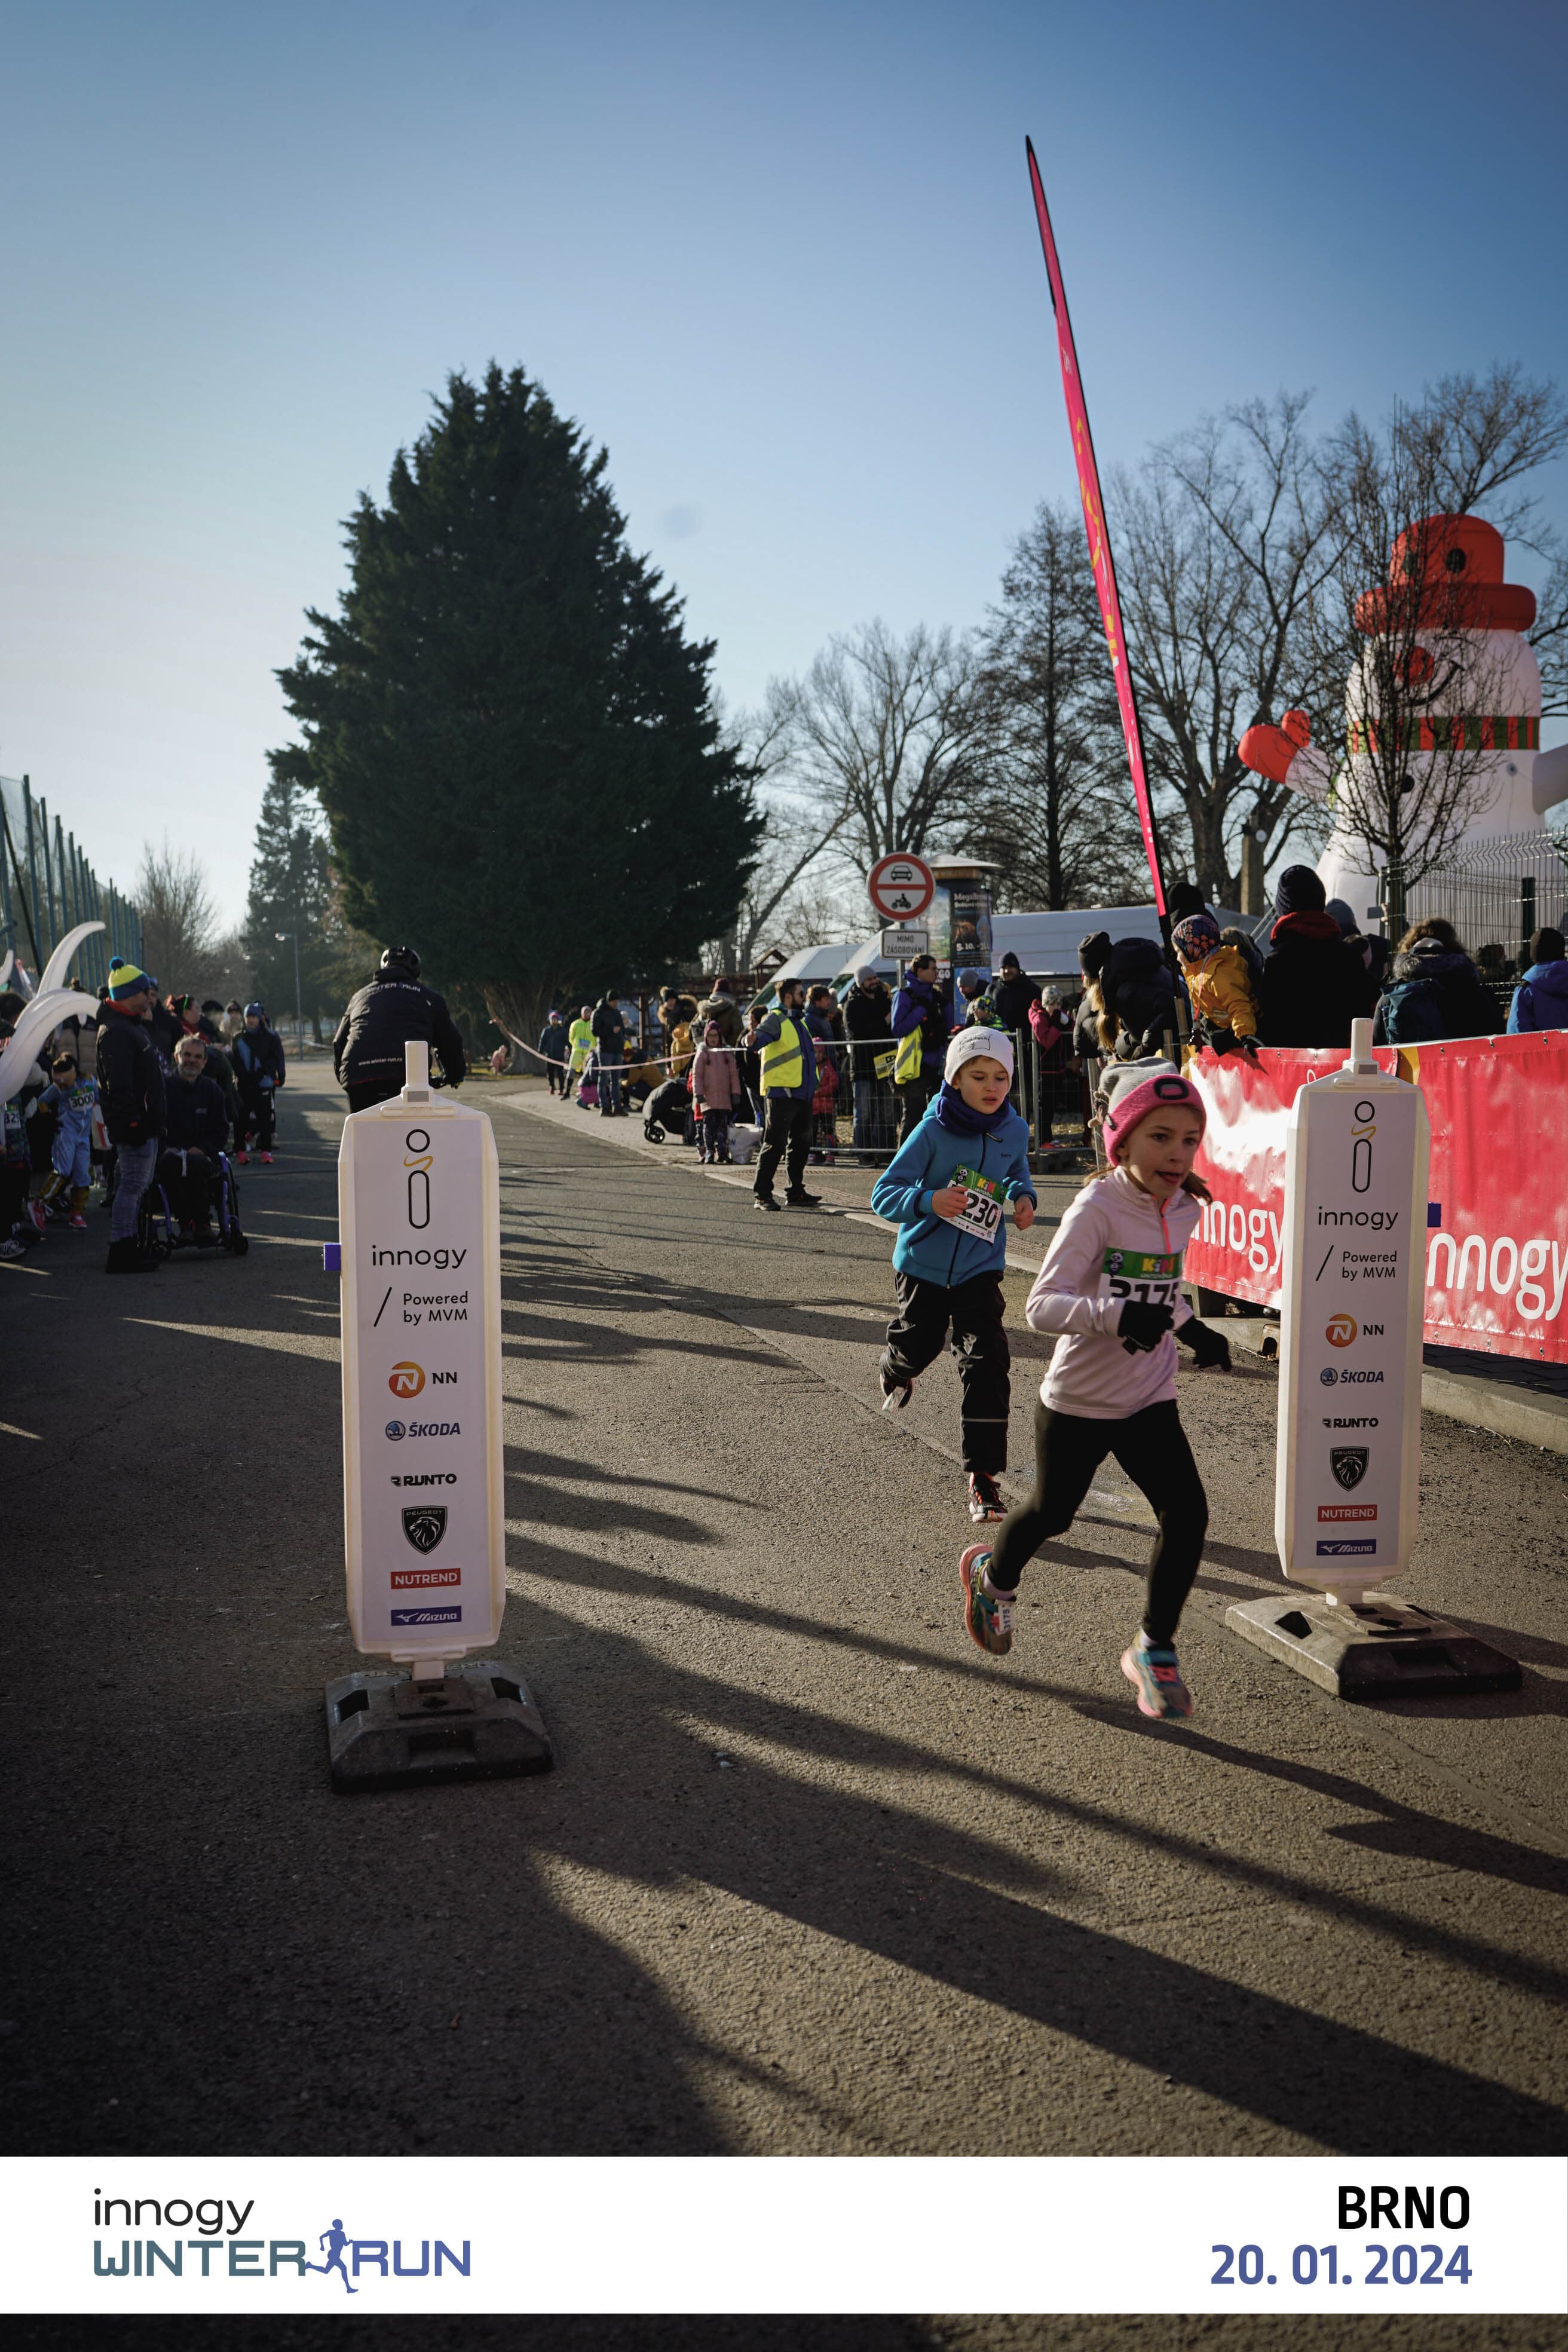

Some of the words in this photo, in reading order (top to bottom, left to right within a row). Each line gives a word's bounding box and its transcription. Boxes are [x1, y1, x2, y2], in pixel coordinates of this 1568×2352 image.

[402, 984, 421, 993] RUN
[956, 1187, 999, 1228] 230
[1319, 1206, 1399, 1231] innogy
[1191, 1198, 1285, 1275] nnogy
[372, 1245, 467, 1270] innogy
[1343, 1251, 1398, 1263] Powered
[1342, 1267, 1358, 1282] by
[1363, 1267, 1396, 1279] MVM
[1426, 1233, 1568, 1321] nnogy
[403, 1291, 468, 1306] Powered
[404, 1310, 422, 1327] by
[428, 1309, 468, 1322] MVM
[1363, 1324, 1385, 1336] NN
[432, 1371, 458, 1385] NN
[1340, 1369, 1385, 1384] ŠKODA
[408, 1422, 461, 1438] ŠKODA
[1333, 1417, 1379, 1429] RUNTO
[403, 1473, 458, 1487] RUNTO
[1321, 1508, 1374, 1519] NUTREND
[394, 1572, 458, 1585] NUTREND
